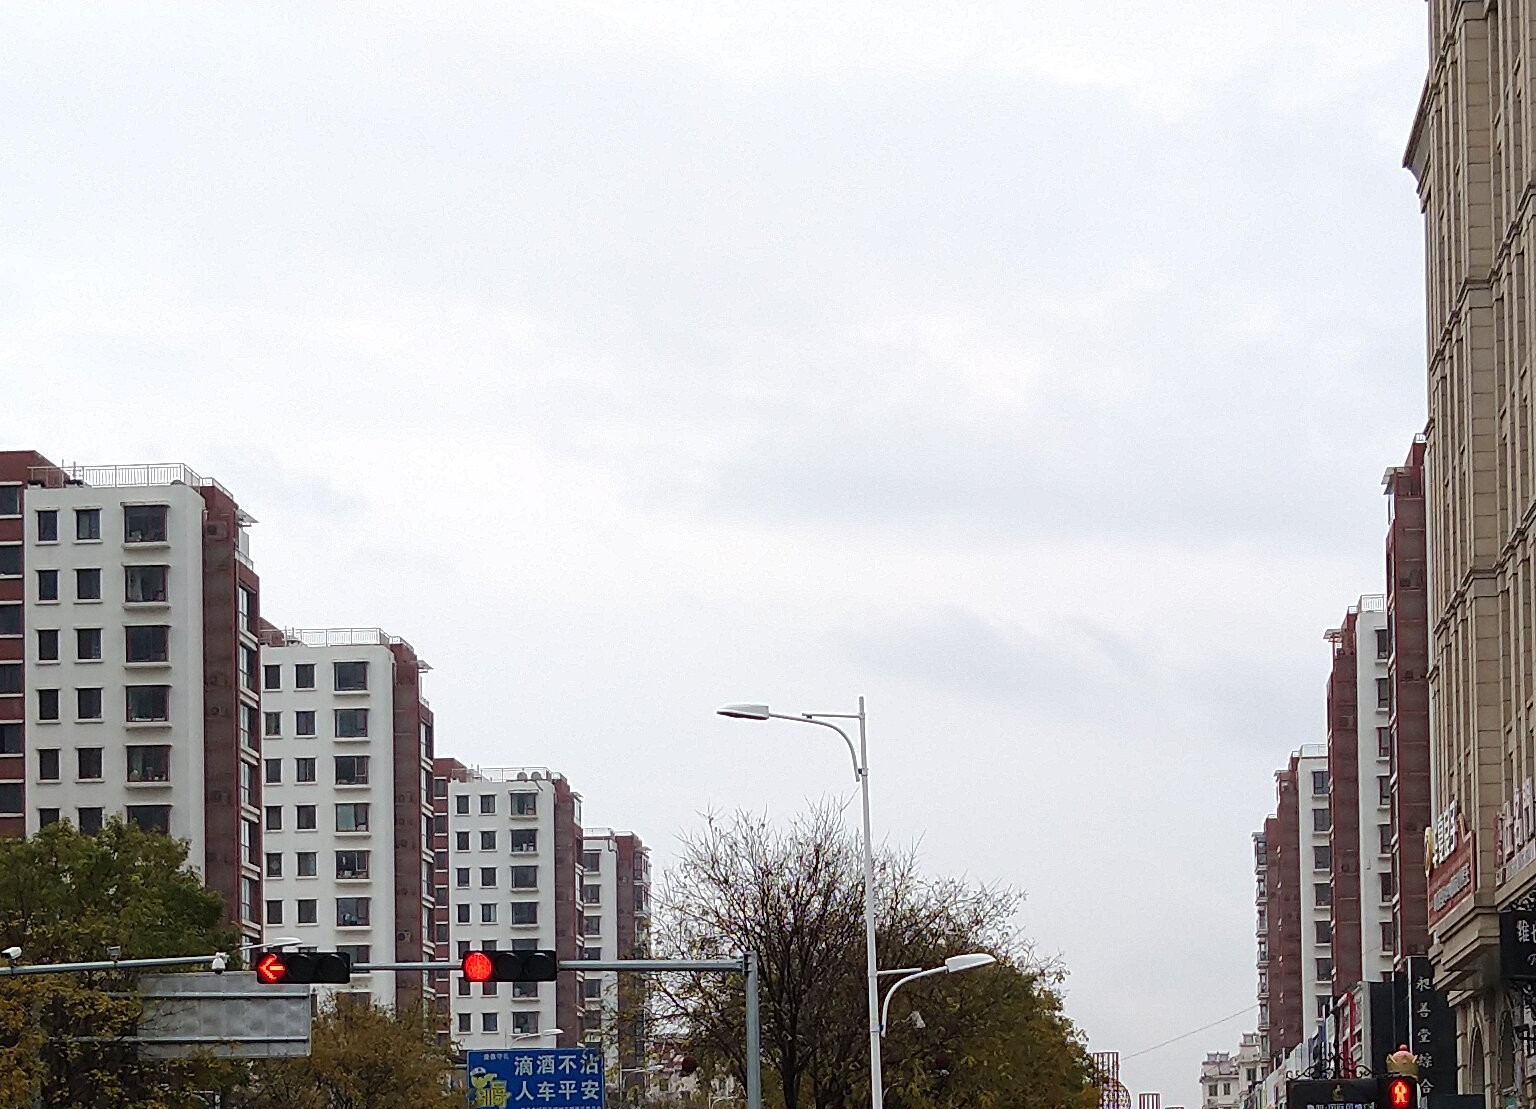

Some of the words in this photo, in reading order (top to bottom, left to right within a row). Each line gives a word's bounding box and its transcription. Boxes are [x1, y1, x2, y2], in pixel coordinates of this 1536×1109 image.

[514, 1053, 599, 1076] 滴酒不沾
[515, 1080, 600, 1101] 人车平安
